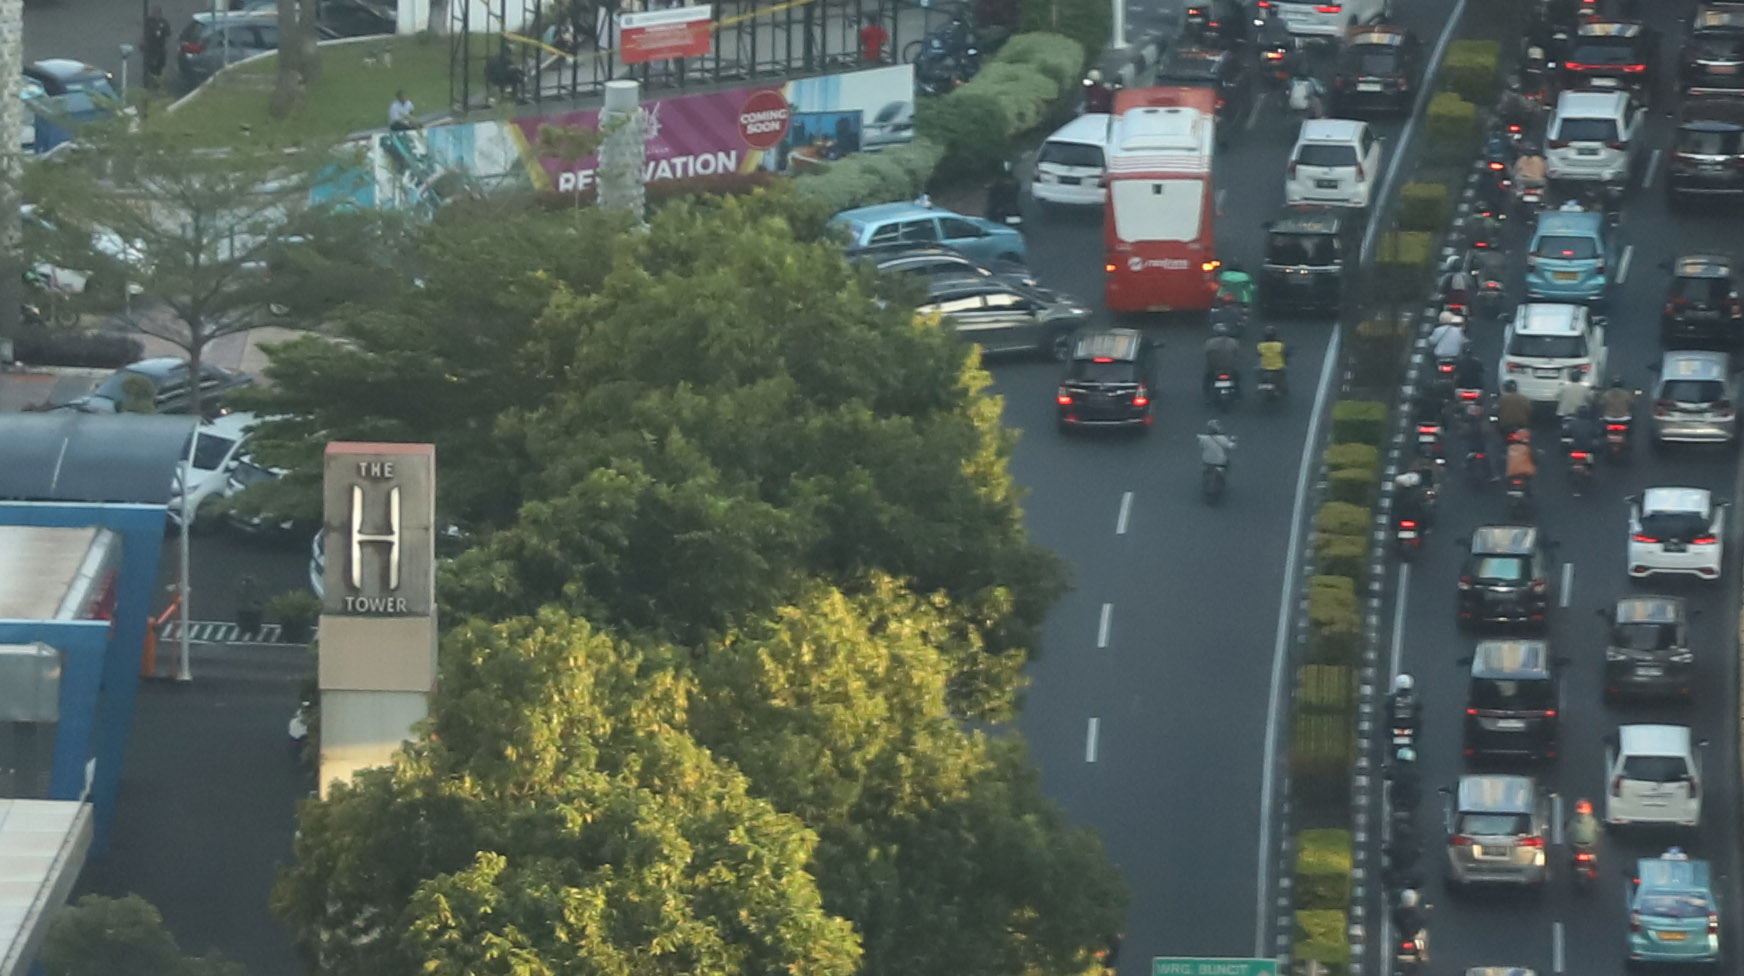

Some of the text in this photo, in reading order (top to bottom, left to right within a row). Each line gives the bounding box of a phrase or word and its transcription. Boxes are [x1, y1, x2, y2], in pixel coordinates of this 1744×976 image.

[740, 109, 787, 125] COMING
[747, 120, 780, 134] SOON
[558, 149, 738, 193] REVATION
[359, 462, 394, 477] THE
[352, 485, 400, 590] H
[345, 596, 407, 613] TOWER
